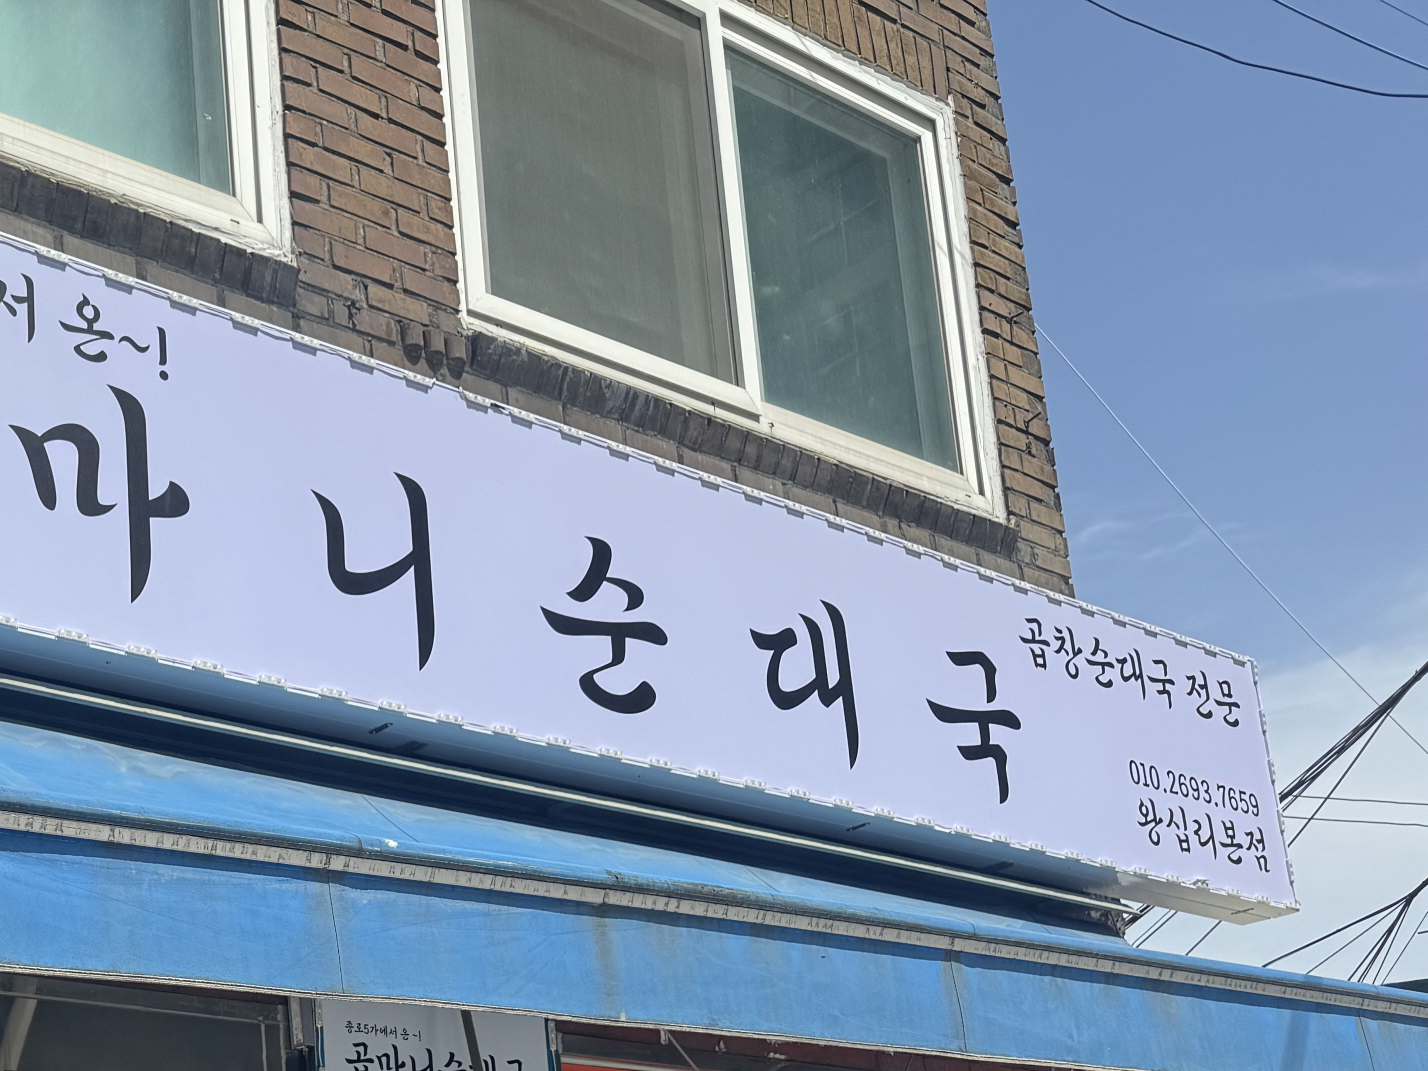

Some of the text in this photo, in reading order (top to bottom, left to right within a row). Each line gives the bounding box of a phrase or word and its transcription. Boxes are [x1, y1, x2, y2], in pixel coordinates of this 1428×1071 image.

[59, 293, 170, 381] 온~!
[1017, 615, 1242, 730] 곱창순대국 전문
[1128, 759, 1260, 818] 010.2693.7659
[1135, 804, 1271, 874] 왕십리본점
[345, 1020, 398, 1040] 종로5가에서
